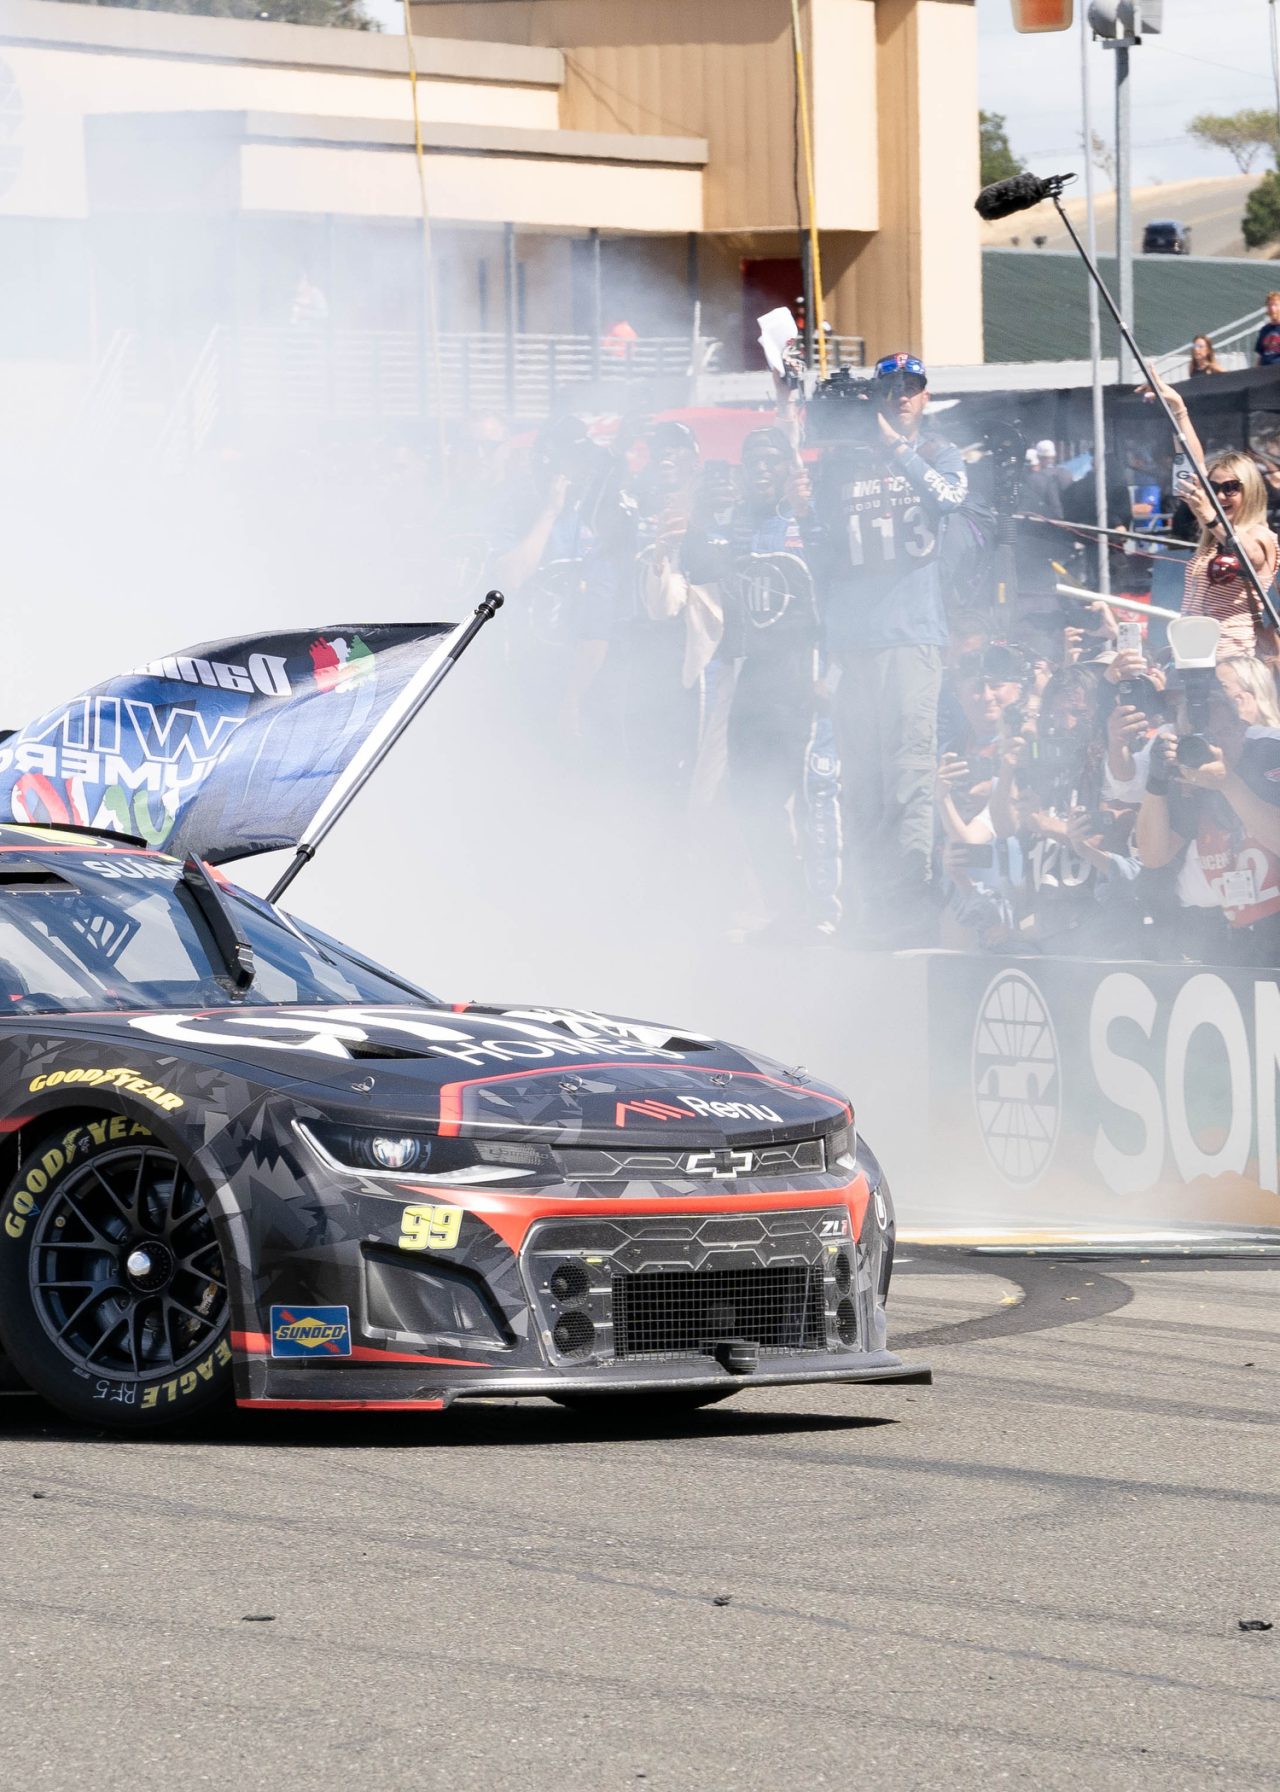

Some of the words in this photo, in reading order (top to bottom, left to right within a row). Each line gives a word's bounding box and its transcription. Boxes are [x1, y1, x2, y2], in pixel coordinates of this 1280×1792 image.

[427, 1038, 687, 1066] HOMES
[28, 1066, 185, 1112] GOODYEAR
[676, 1095, 784, 1124] Renu
[5, 1115, 153, 1239] GOODYEA
[398, 1204, 464, 1250] 99
[277, 1326, 346, 1339] SUNOCO
[140, 1338, 233, 1409] EAGLE
